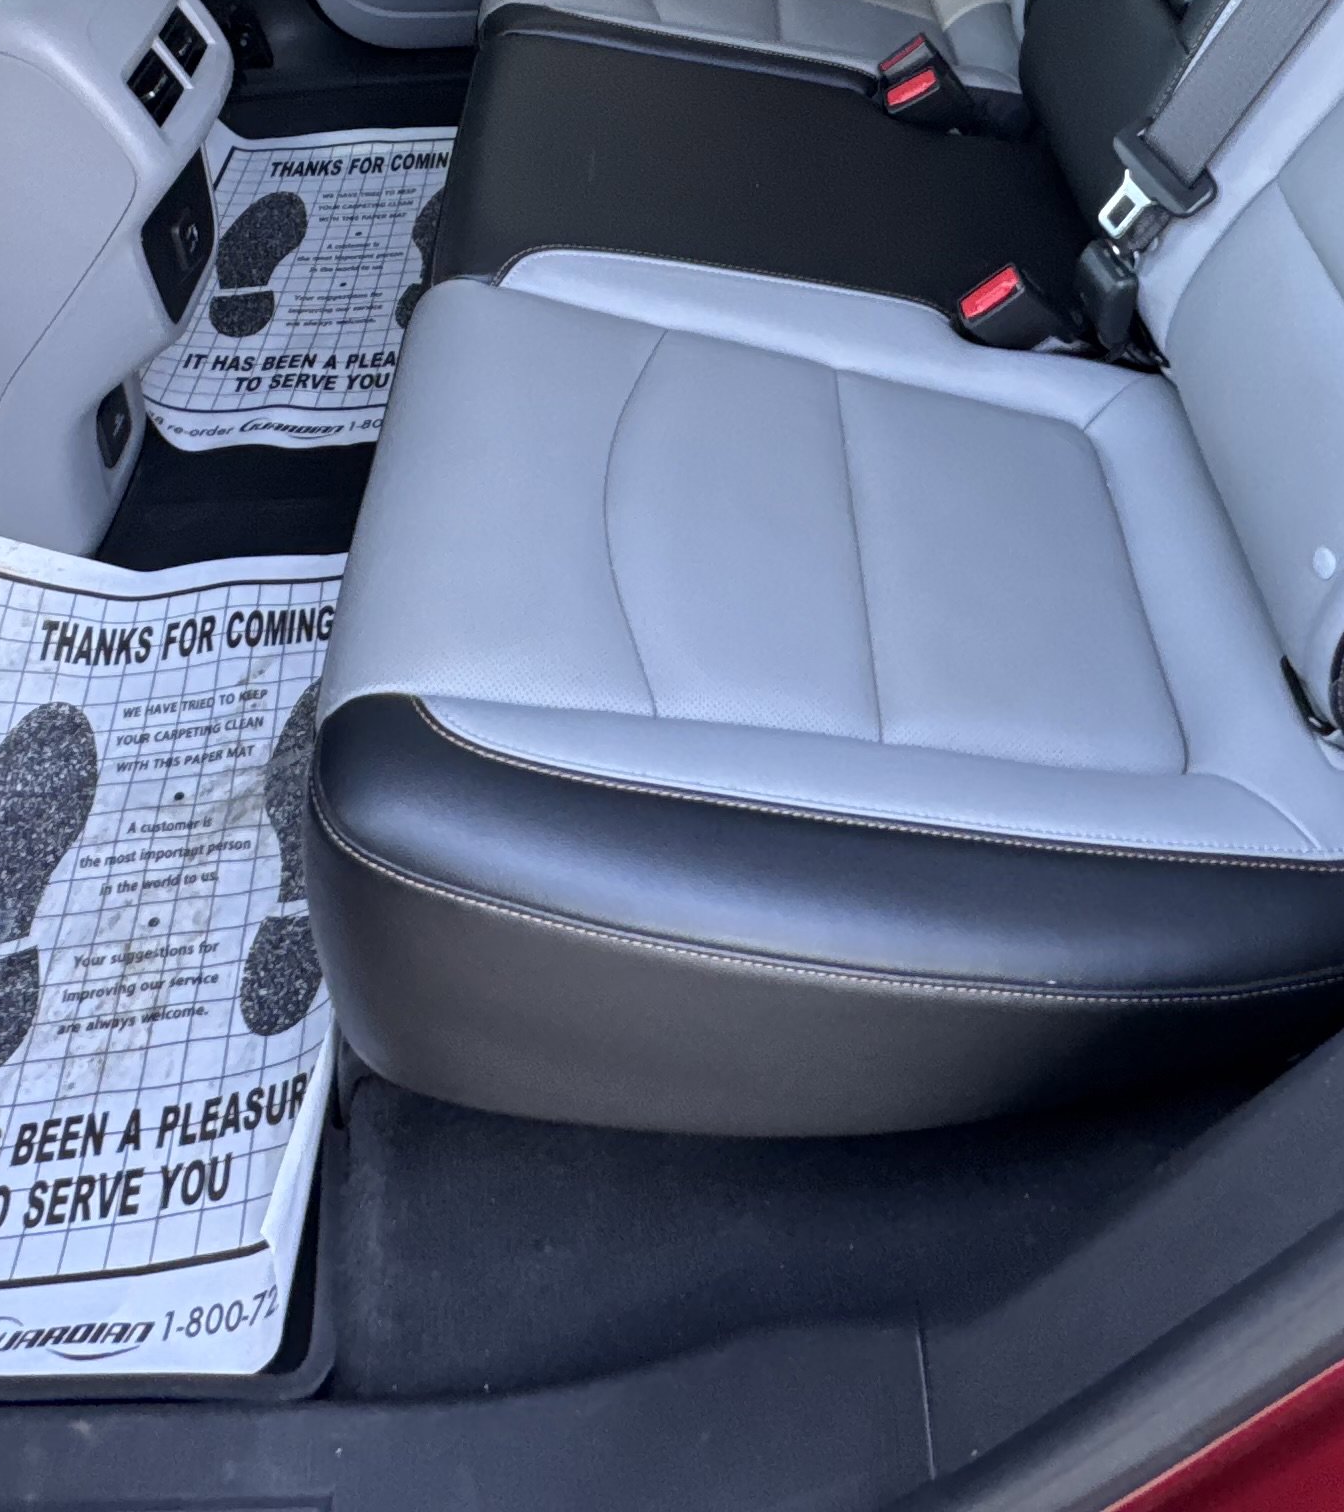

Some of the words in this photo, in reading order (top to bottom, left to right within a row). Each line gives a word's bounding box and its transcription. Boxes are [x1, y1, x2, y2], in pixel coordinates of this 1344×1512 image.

[270, 159, 343, 177] THANKS
[348, 156, 385, 175] FOR
[183, 353, 208, 370] IT
[211, 355, 255, 372] HAS
[261, 353, 317, 371] BEEN
[322, 354, 337, 370] A
[234, 377, 262, 392] TO
[268, 374, 337, 390] SERVE
[346, 372, 391, 390] YOU
[167, 424, 234, 436] re-order
[40, 619, 153, 666] THANKS
[161, 615, 216, 661] FOR
[226, 605, 336, 649] COMING
[123, 705, 142, 719] WE
[145, 701, 177, 716] HAVE
[180, 696, 215, 712] TRIED
[219, 693, 235, 706] TO
[239, 689, 268, 702] KEEP
[116, 733, 150, 746] YOUR
[154, 720, 221, 743] CARPETING
[224, 716, 264, 731] CLEAN
[116, 759, 149, 773] WITH
[153, 755, 181, 769] THIS
[184, 750, 223, 766] PAPER
[226, 745, 255, 759] MAT
[127, 822, 136, 834] A
[140, 819, 199, 834] customer
[202, 815, 213, 828] is
[79, 855, 101, 869] the
[104, 850, 136, 866] most
[139, 844, 205, 863] important
[207, 839, 252, 856] person
[99, 882, 112, 897] in
[116, 880, 138, 894] the
[142, 873, 180, 890] world
[183, 872, 197, 886] to
[74, 955, 106, 969] Your
[110, 943, 195, 965] suggestions
[198, 940, 220, 955] for
[140, 979, 165, 992] our
[168, 973, 219, 989] service
[57, 1022, 81, 1035] are
[86, 1015, 136, 1032] always
[141, 1005, 209, 1024] welcome.
[10, 1108, 110, 1167] BEEN
[117, 1108, 141, 1154] A
[155, 1064, 315, 1149] PLEASUR
[23, 1167, 145, 1229] SERVE
[159, 1152, 233, 1210] YOU
